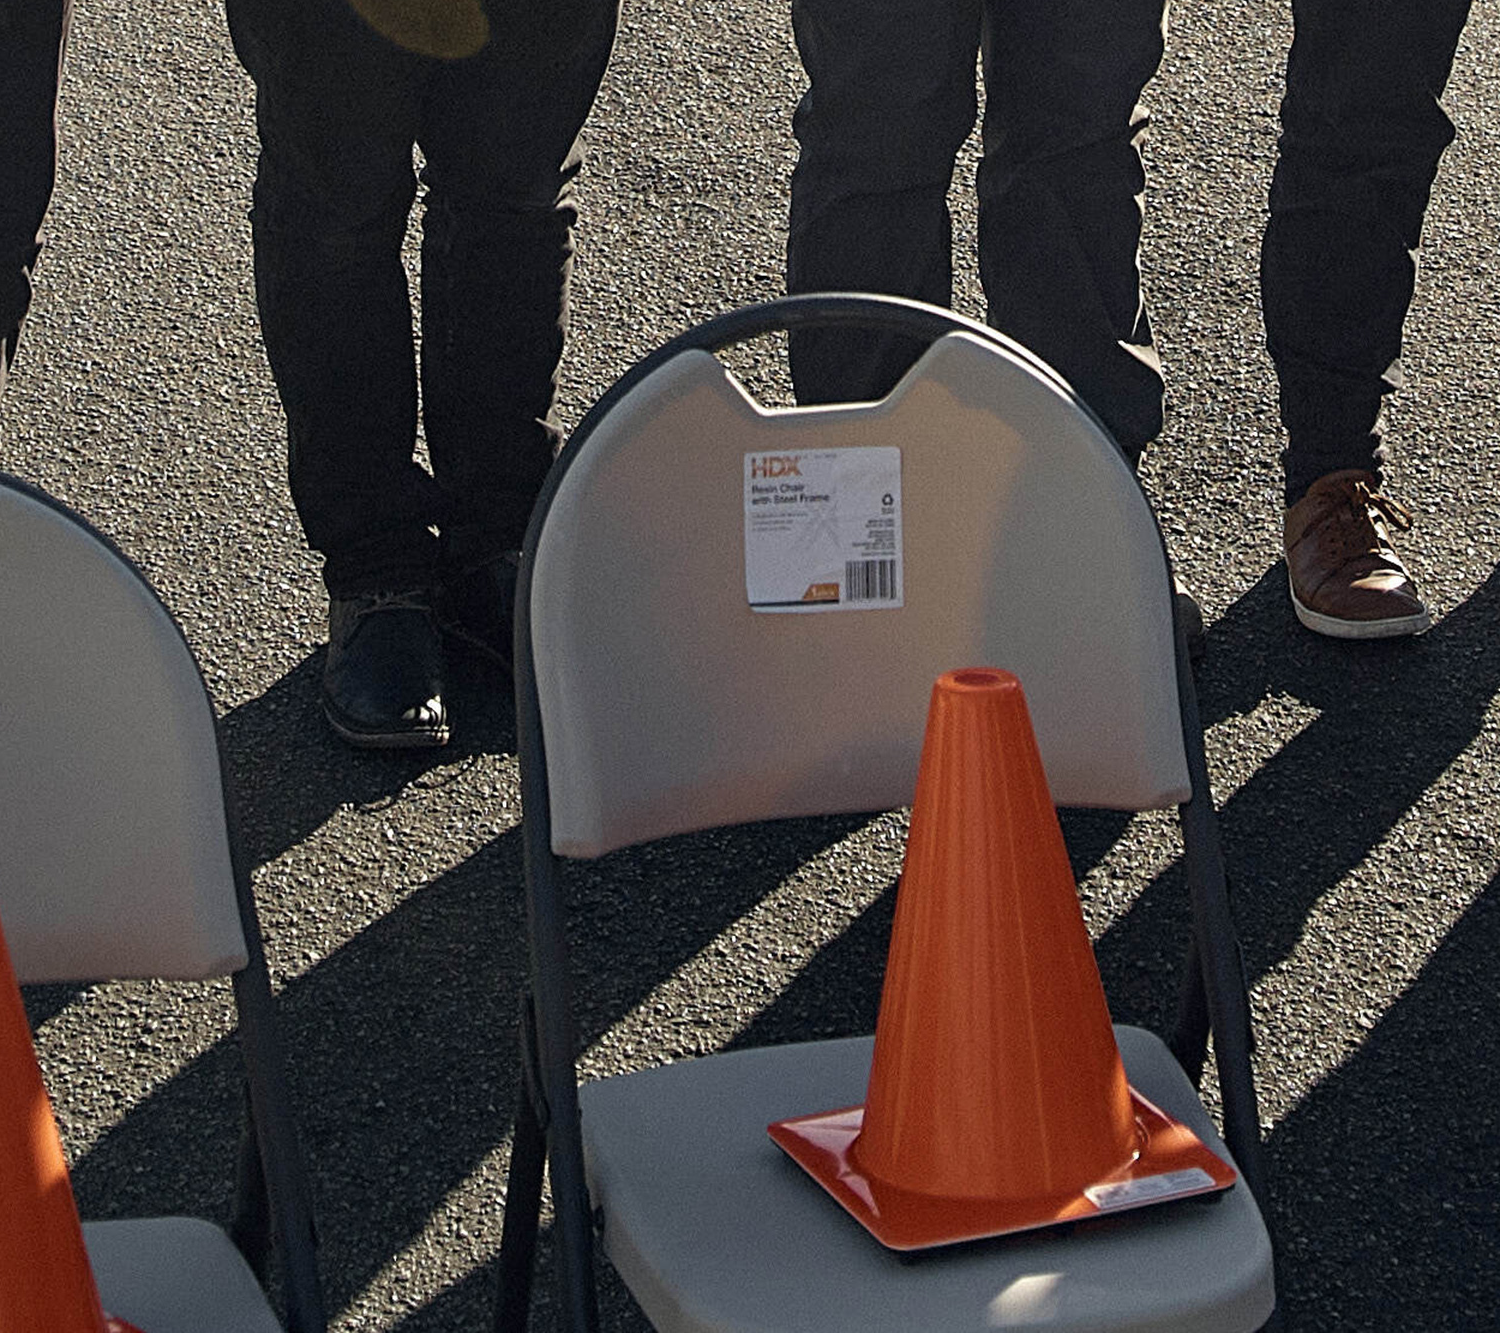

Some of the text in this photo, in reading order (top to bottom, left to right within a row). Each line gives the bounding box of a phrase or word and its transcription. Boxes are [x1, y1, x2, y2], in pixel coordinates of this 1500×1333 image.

[751, 455, 802, 479] HDX
[751, 483, 804, 495] Resin Chair
[774, 494, 797, 505] Steel
[800, 493, 830, 503] Frame
